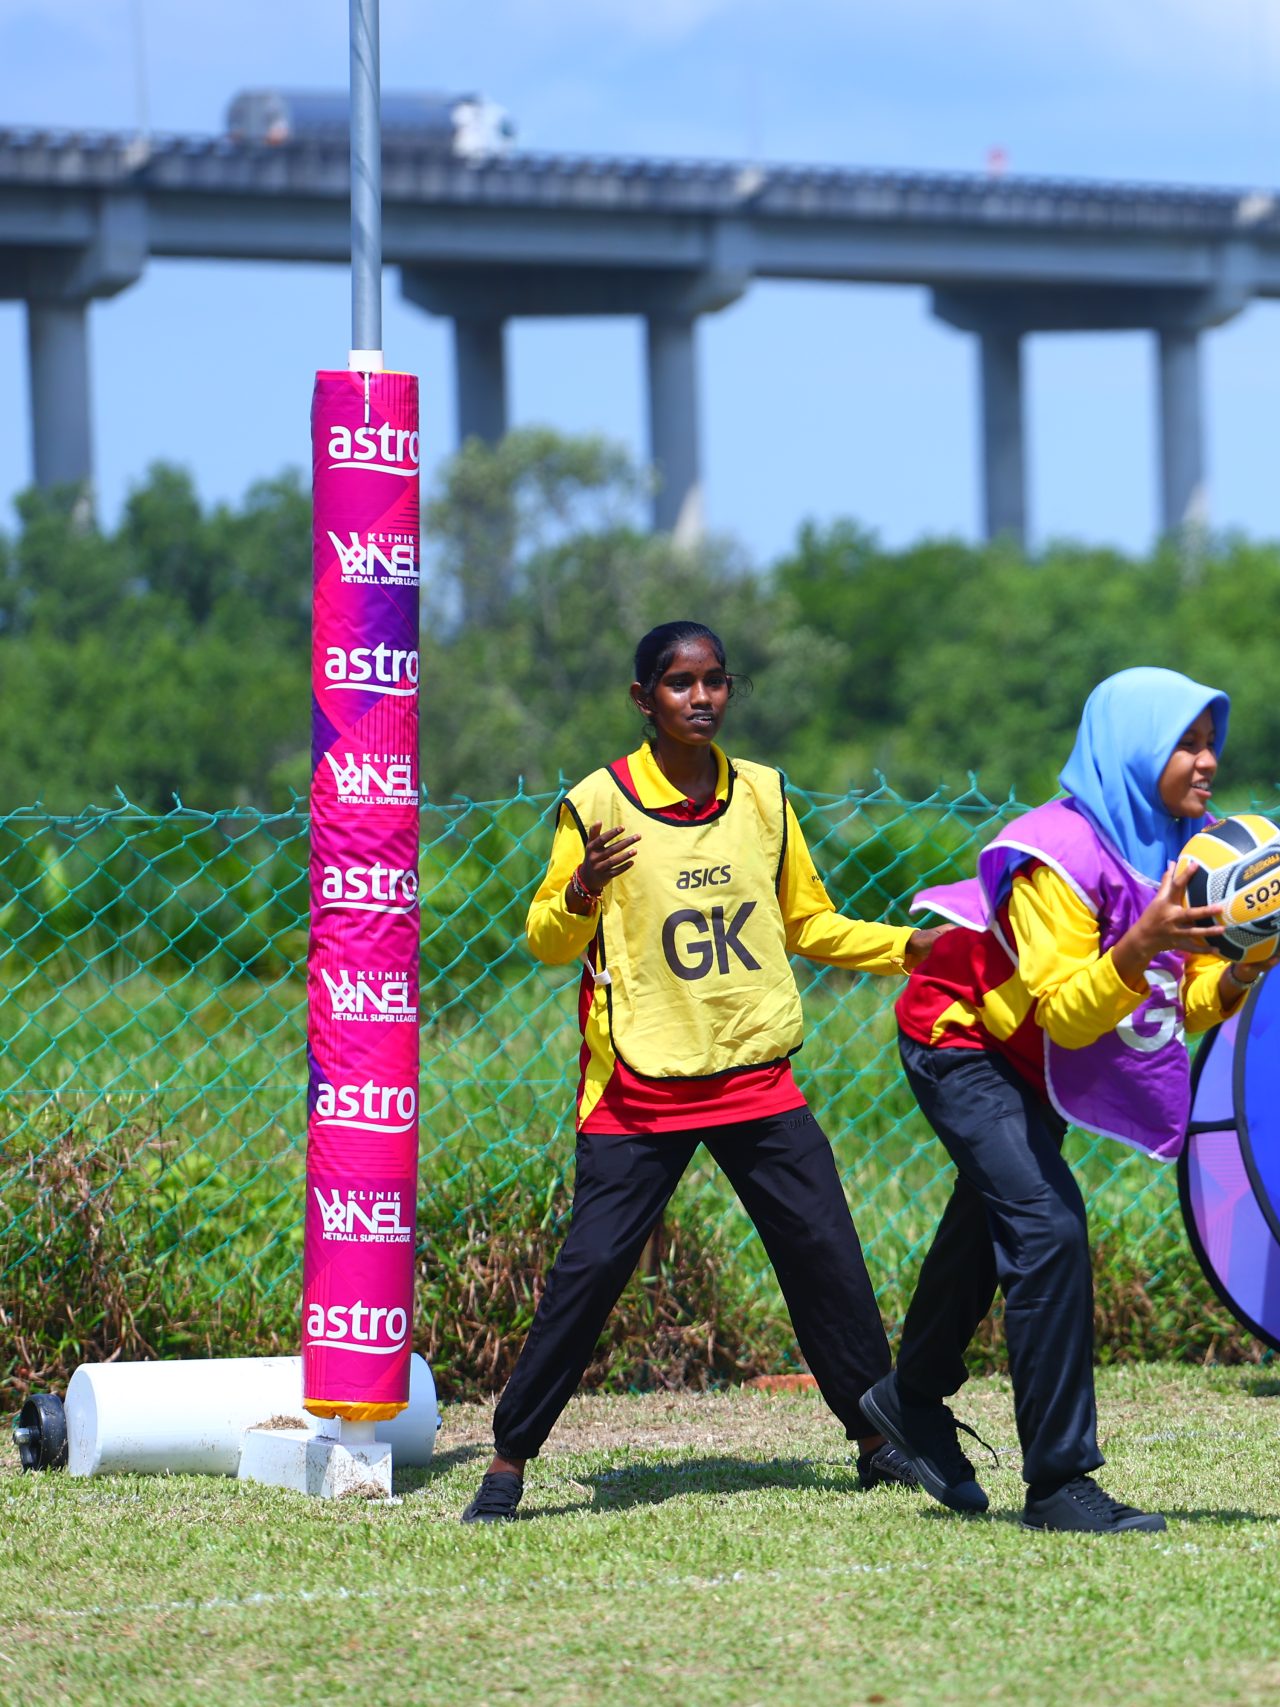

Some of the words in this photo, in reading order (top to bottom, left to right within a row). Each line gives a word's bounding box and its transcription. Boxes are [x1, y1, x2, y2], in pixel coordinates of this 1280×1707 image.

[328, 421, 418, 464] astro
[367, 533, 414, 544] KLINIK
[366, 543, 419, 577] NSL
[341, 575, 380, 584] NETBALL
[381, 576, 403, 586] SUPER
[324, 641, 418, 683] astro
[362, 753, 411, 763] KLINIK
[361, 763, 418, 797] NSL
[337, 796, 374, 804] NETBALL
[376, 797, 400, 805] SUPER
[322, 861, 418, 901] astro
[661, 901, 762, 981] GK
[356, 970, 408, 981] KLINIK
[356, 980, 417, 1013] NSL
[1116, 968, 1185, 1053] G
[331, 1012, 368, 1022] NETBALL
[370, 1014, 395, 1022] SUPER
[395, 1014, 417, 1022] LEAGUE
[316, 1080, 416, 1119] astro
[347, 1190, 400, 1201] KLINIK
[345, 1200, 411, 1234] NSL
[322, 1232, 358, 1242] NETBALL
[360, 1234, 385, 1243] SUPER
[386, 1235, 411, 1243] LEAGUE
[307, 1300, 407, 1340] astro
